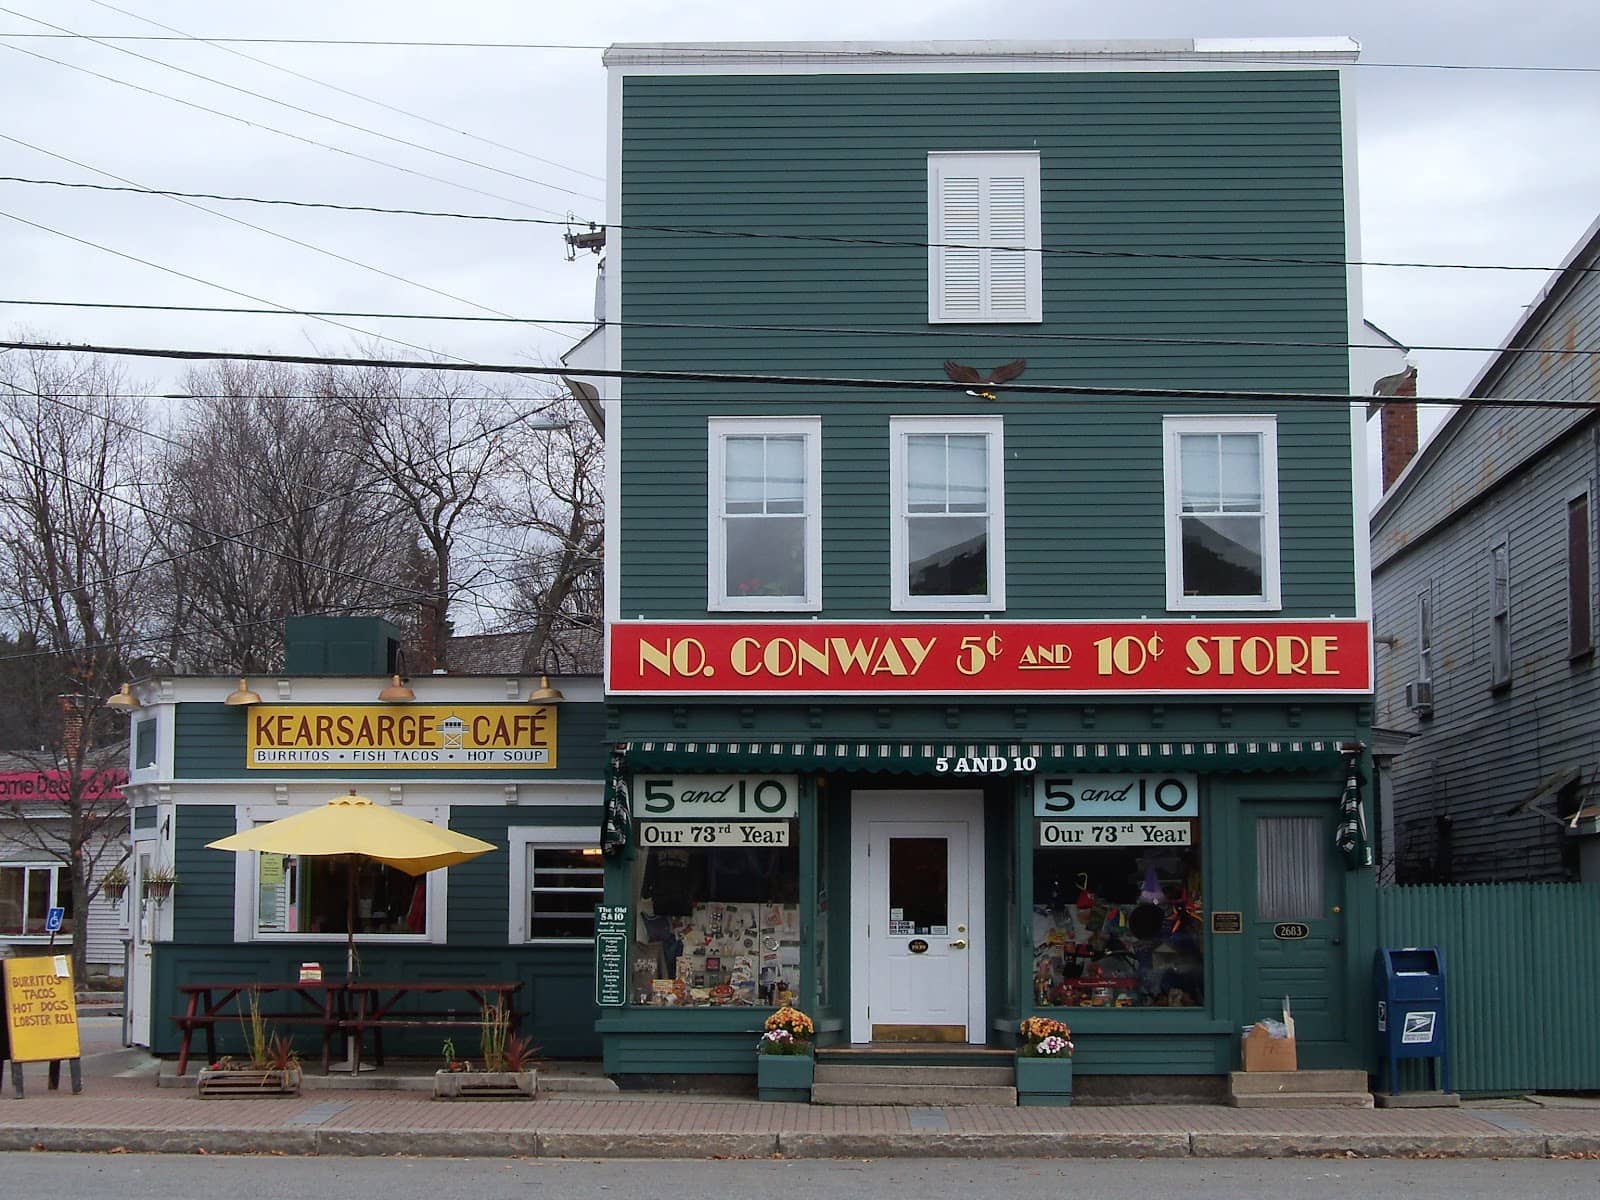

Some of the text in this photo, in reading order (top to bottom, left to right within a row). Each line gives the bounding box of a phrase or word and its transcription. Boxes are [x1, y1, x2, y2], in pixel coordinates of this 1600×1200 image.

[639, 631, 1341, 677] NO. CONWAY 5¢ AND 10¢ STORE
[256, 708, 548, 747] KEARSARGE CAFÉ
[257, 750, 543, 761] BURRITOS FISH TACOS HOT SOUP
[936, 757, 1037, 773] 5 AND 10
[645, 780, 787, 813] 5 and 10
[1044, 778, 1188, 812] 5 and 10
[644, 826, 683, 843] Our
[739, 826, 785, 843] Year
[1044, 825, 1084, 843] Our
[1141, 825, 1187, 843] Year
[1280, 926, 1302, 936] 2683
[12, 975, 62, 988] BURRITOS
[22, 988, 57, 1000] TACOS
[13, 1000, 69, 1014] HOT DOGS
[14, 1013, 75, 1027] LOBSTER ROLL
